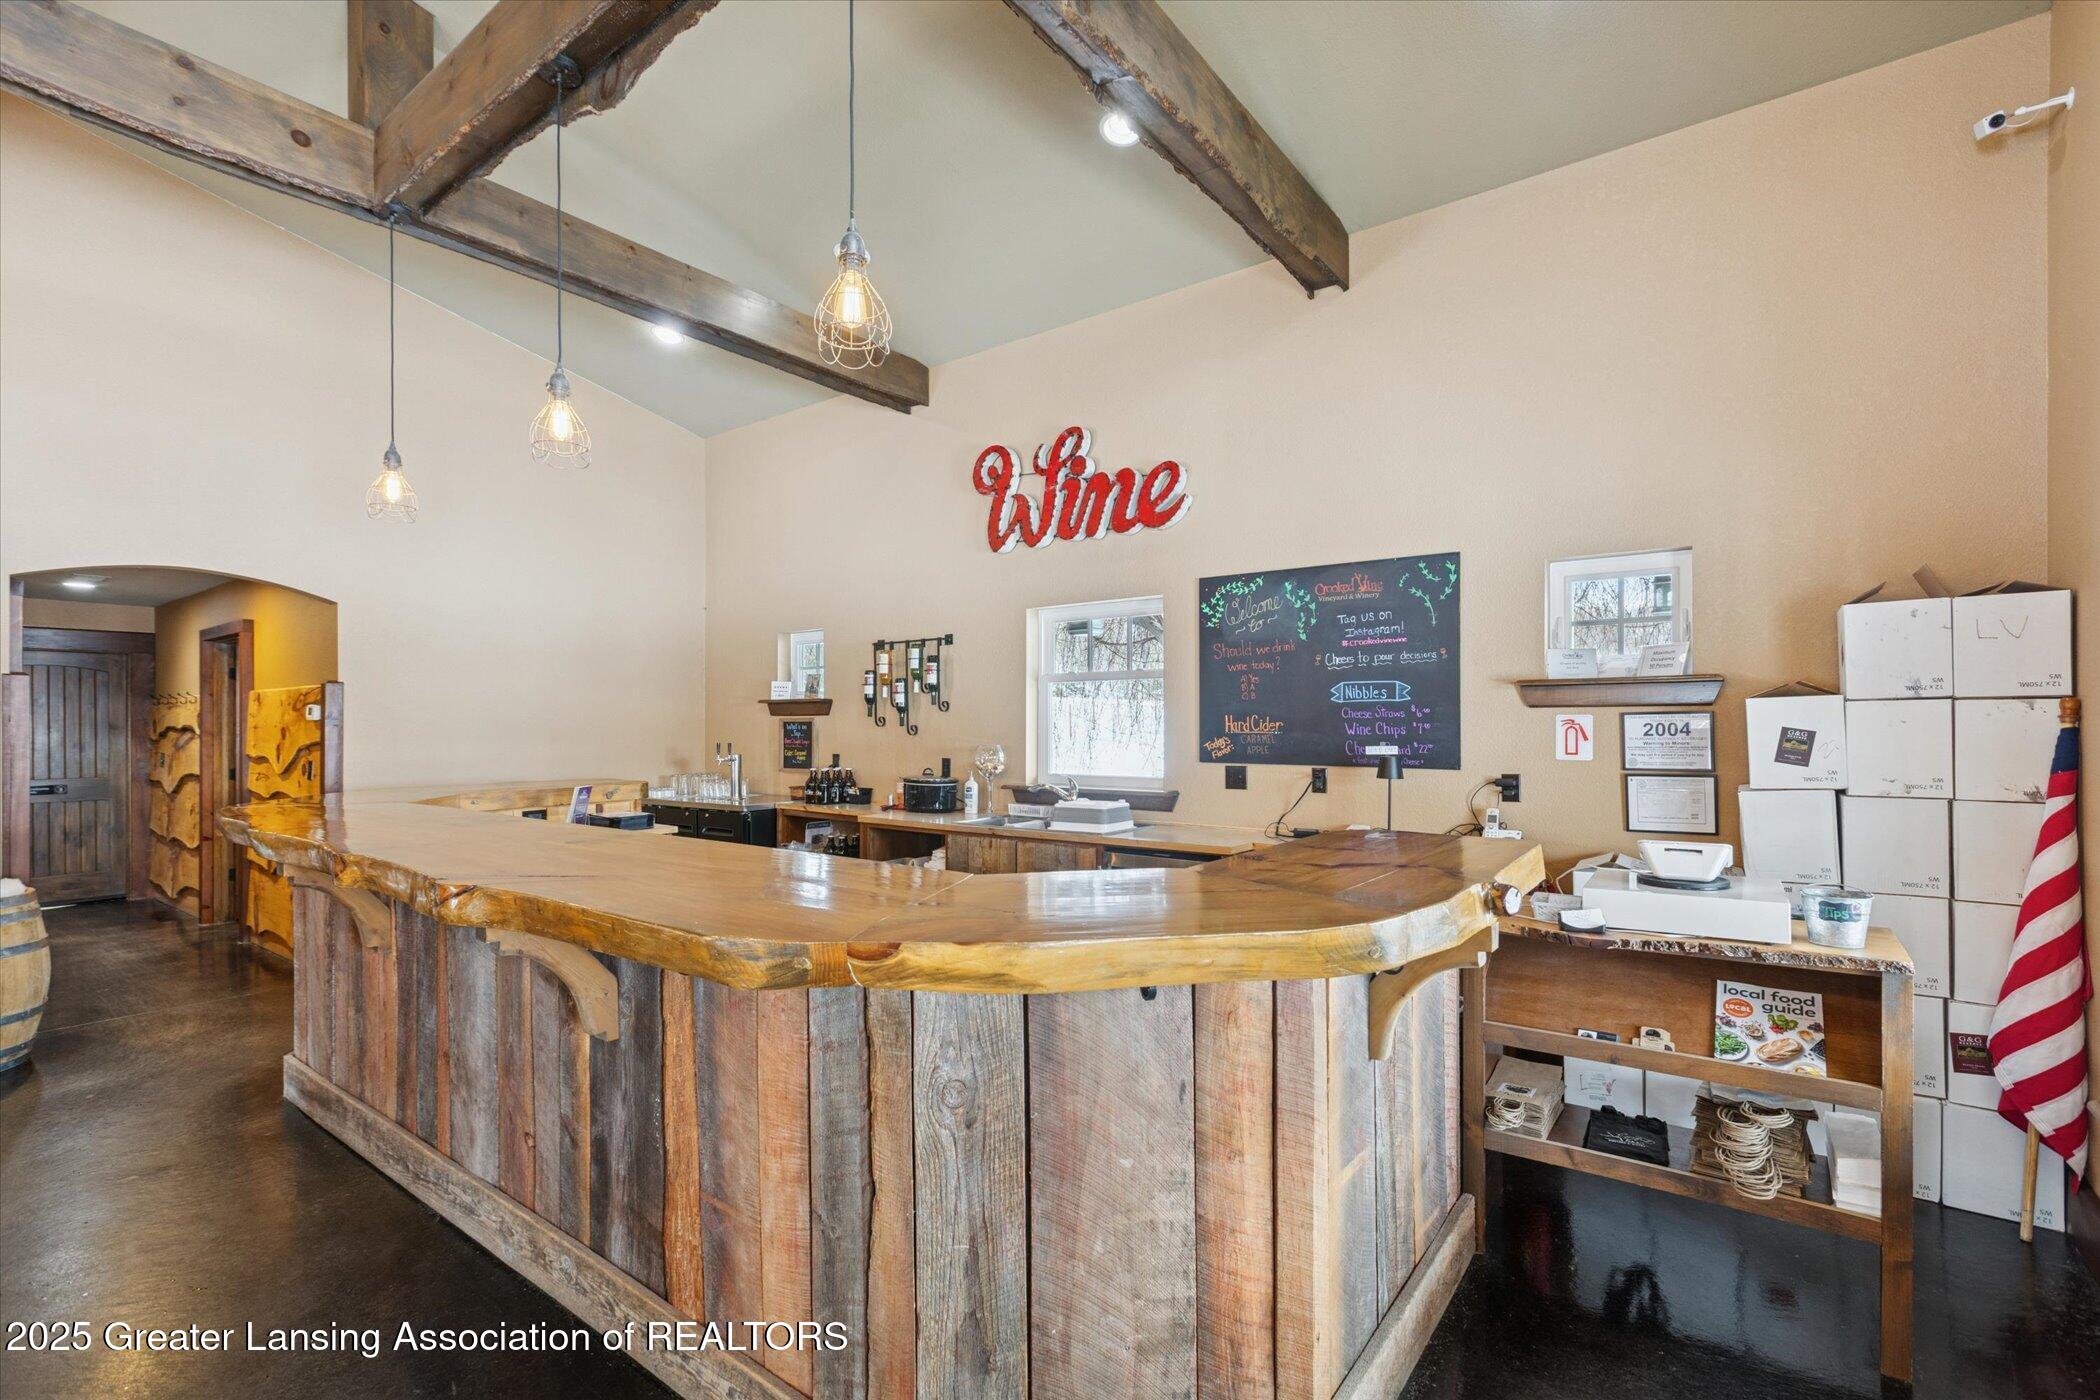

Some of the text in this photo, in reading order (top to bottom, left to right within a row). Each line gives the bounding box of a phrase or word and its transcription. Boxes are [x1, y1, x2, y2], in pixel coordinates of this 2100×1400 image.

[973, 426, 1193, 554] Wine
[1318, 593, 1348, 602] Vineyard
[1225, 595, 1283, 625] Welcome
[1247, 619, 1265, 632] to
[1337, 614, 1356, 626] Tag
[1379, 611, 1393, 620] on
[1345, 620, 1405, 637] Instagram!
[1213, 640, 1296, 660] Should we drink
[1325, 651, 1437, 666] Cheers to pour decisions
[1227, 664, 1248, 672] wine
[1345, 685, 1387, 699] Nibbles
[1342, 706, 1373, 719] Cheese
[1375, 705, 1405, 718] Straws
[1225, 714, 1284, 732] Hard Cider
[1345, 721, 1372, 735] Wine
[1375, 721, 1406, 738] Chips
[1643, 722, 1691, 736] 2004
[1247, 745, 1269, 755] APPLE
[1723, 984, 1815, 1007] local food
[1762, 1003, 1816, 1018] guide
[1958, 1035, 1982, 1043] G&G
